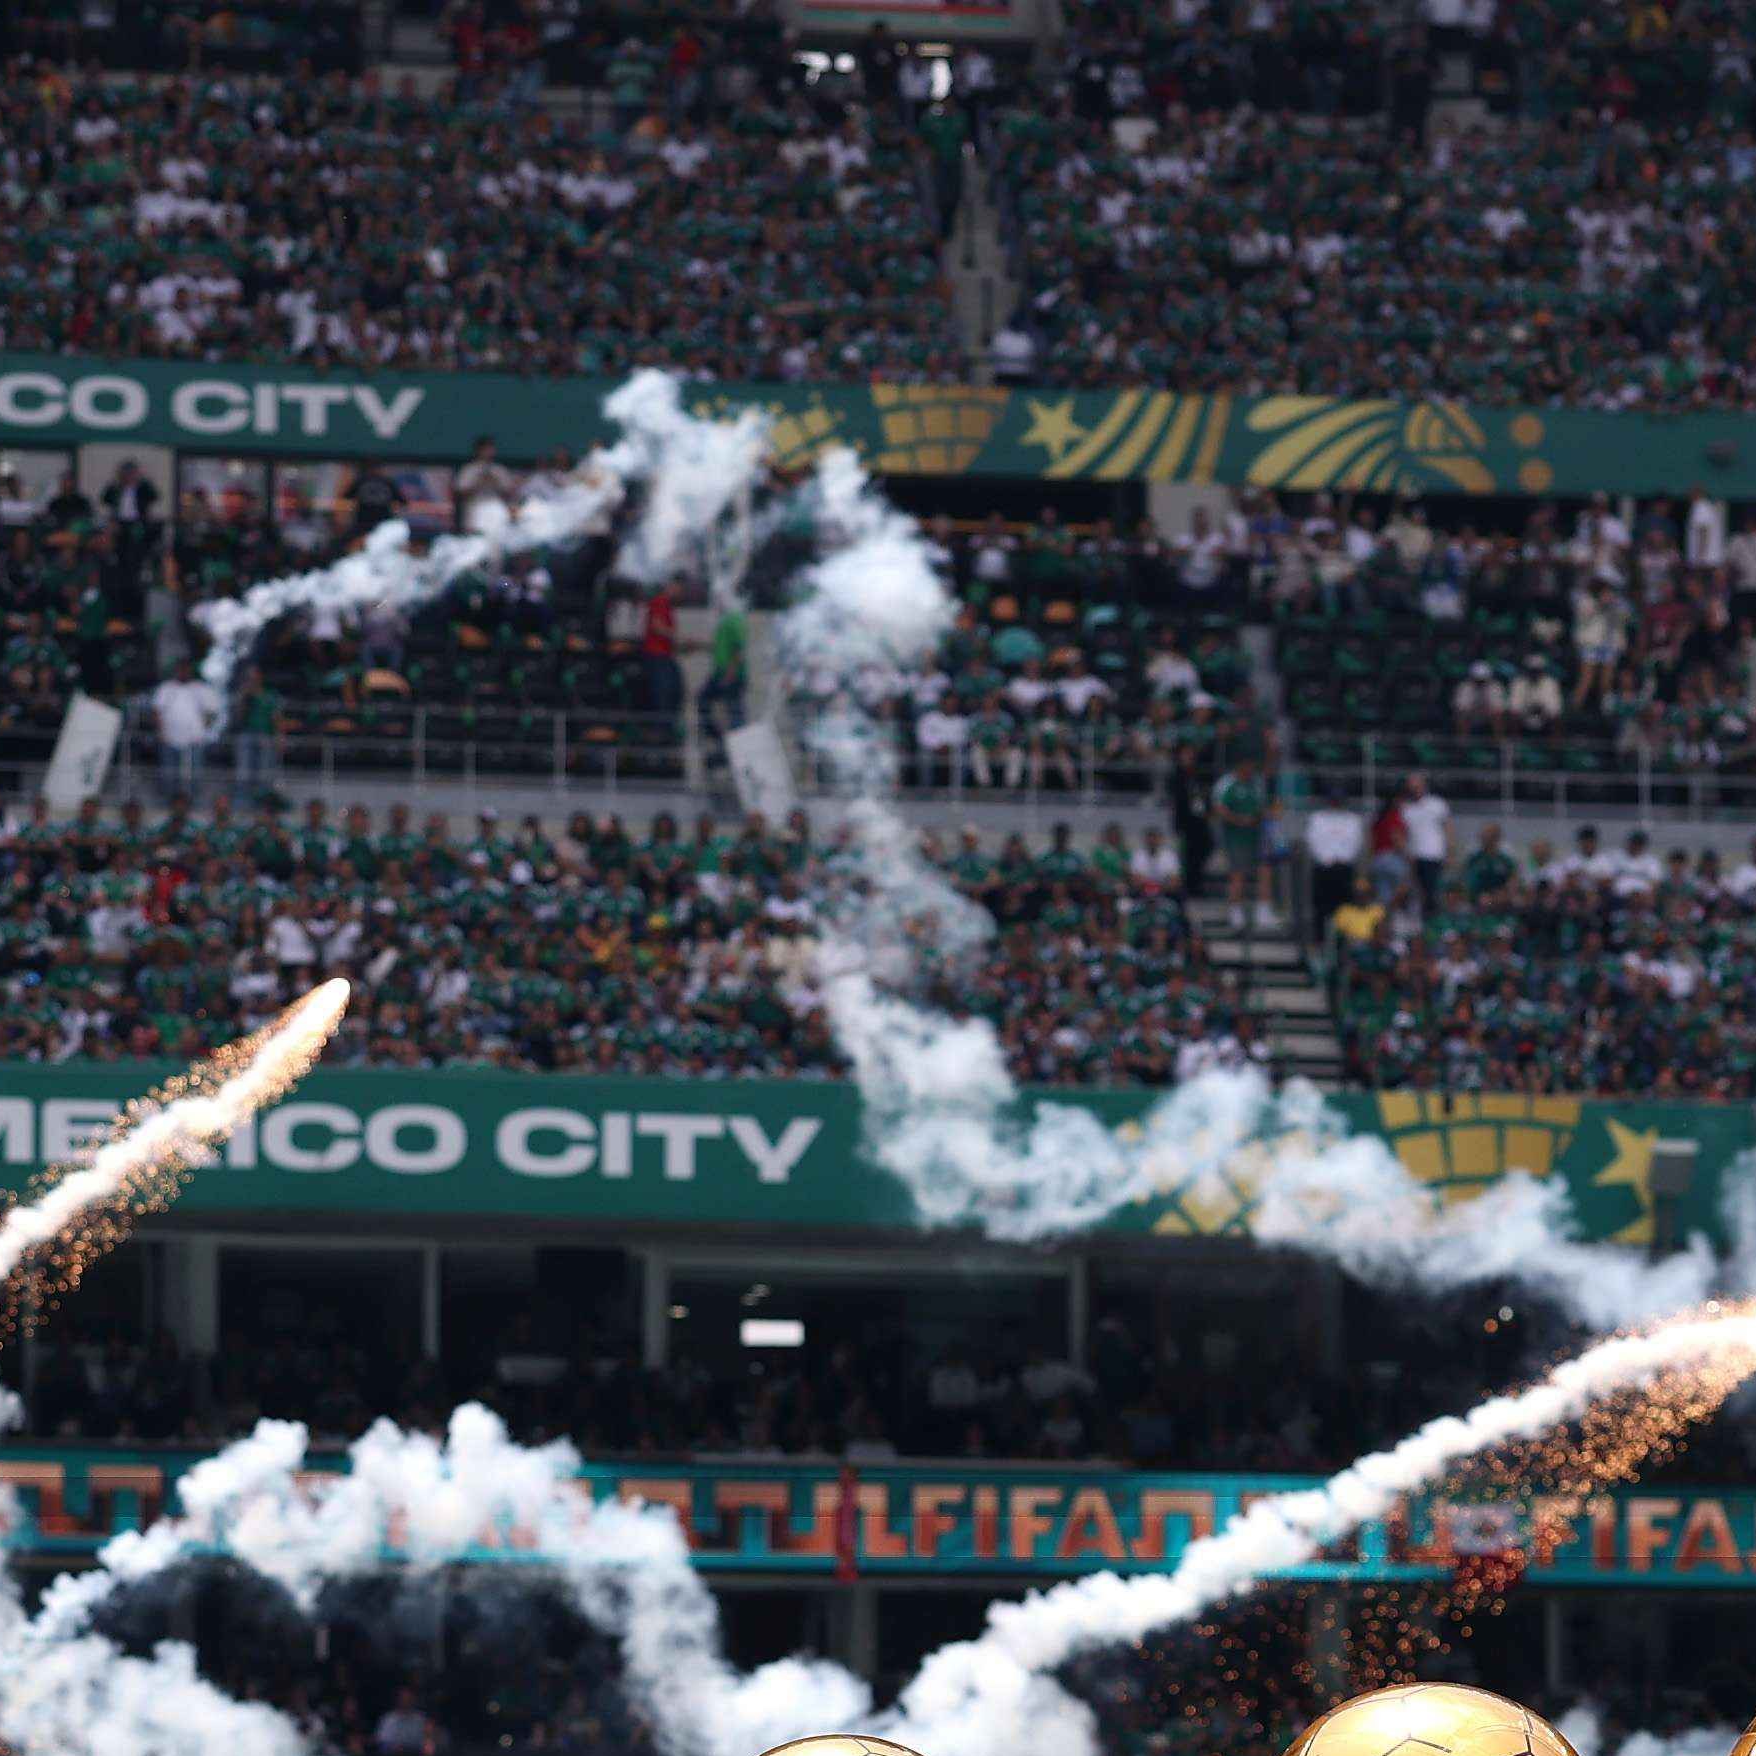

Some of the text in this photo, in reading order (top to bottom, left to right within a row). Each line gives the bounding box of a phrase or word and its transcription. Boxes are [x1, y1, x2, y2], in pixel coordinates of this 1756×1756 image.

[170, 380, 425, 437] CITY
[494, 1108, 823, 1184] CITY
[913, 1485, 1127, 1560] FIFA
[1533, 1496, 1743, 1574] FIFA
